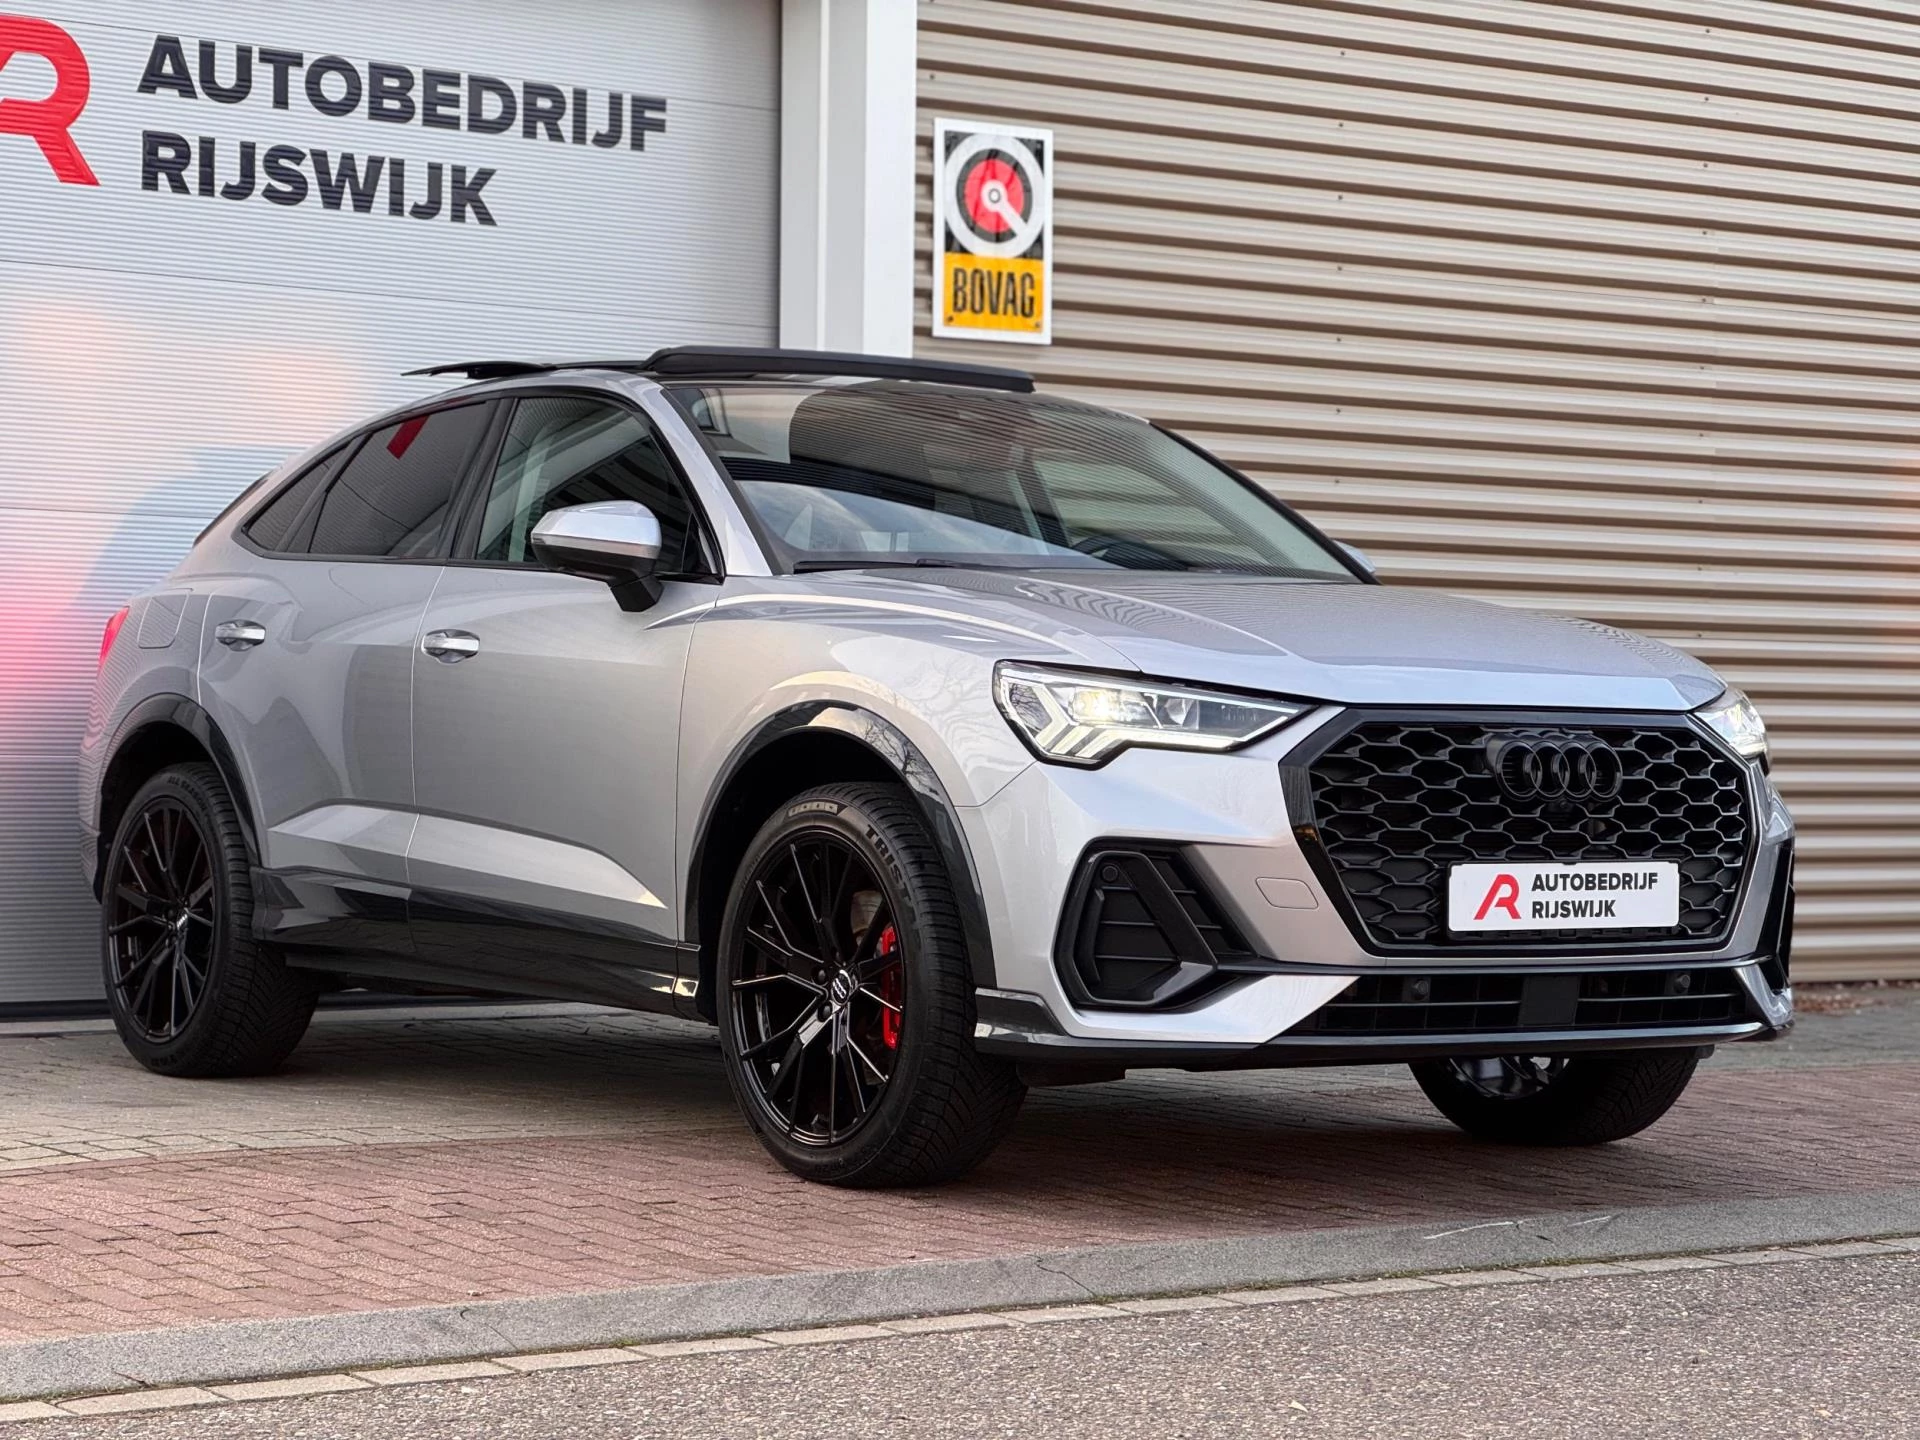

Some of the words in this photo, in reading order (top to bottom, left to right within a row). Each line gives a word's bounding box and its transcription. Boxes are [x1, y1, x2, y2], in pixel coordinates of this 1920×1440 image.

[137, 35, 667, 152] AUTOBEDRIJF
[141, 130, 497, 226] RIJSWIJK
[953, 268, 1035, 319] BOVAG
[1531, 872, 1658, 892] AUTOBEDRIJF
[1531, 899, 1616, 919] RIJSWIJK
